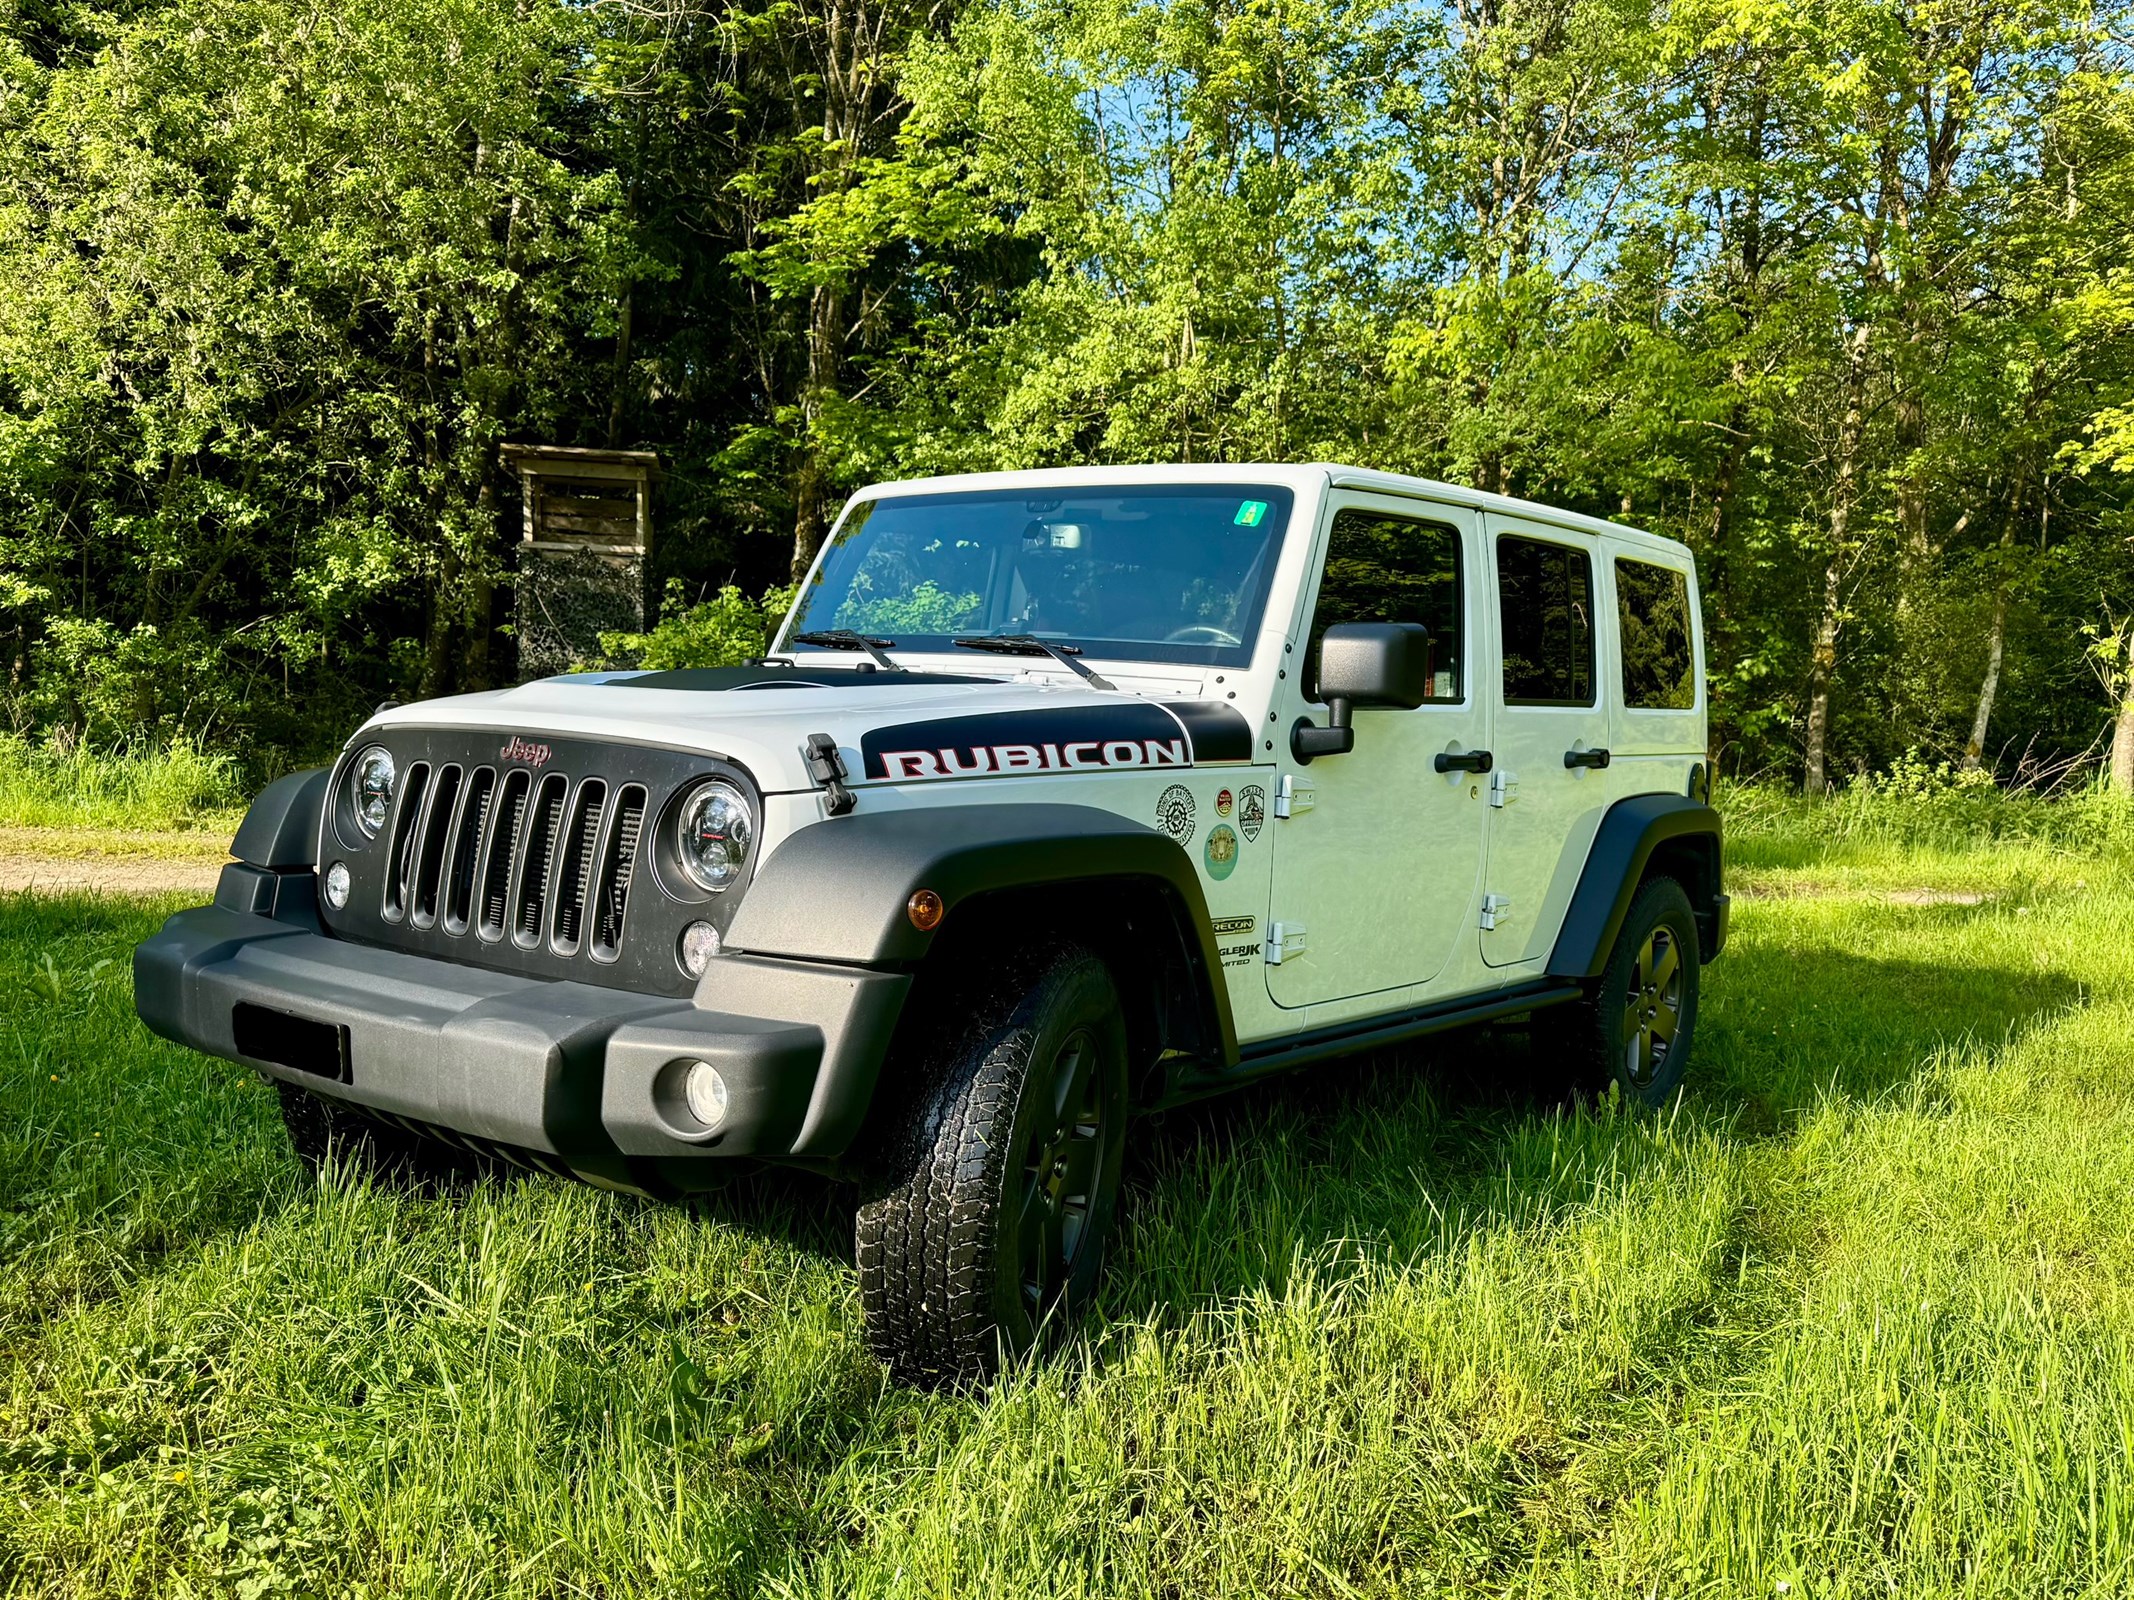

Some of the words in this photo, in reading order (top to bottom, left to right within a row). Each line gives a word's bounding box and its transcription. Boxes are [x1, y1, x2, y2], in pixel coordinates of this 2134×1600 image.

[500, 736, 552, 768] Jeep
[880, 740, 1186, 778] RUBICON
[1241, 786, 1262, 797] SWISS
[1213, 920, 1252, 931] RECON
